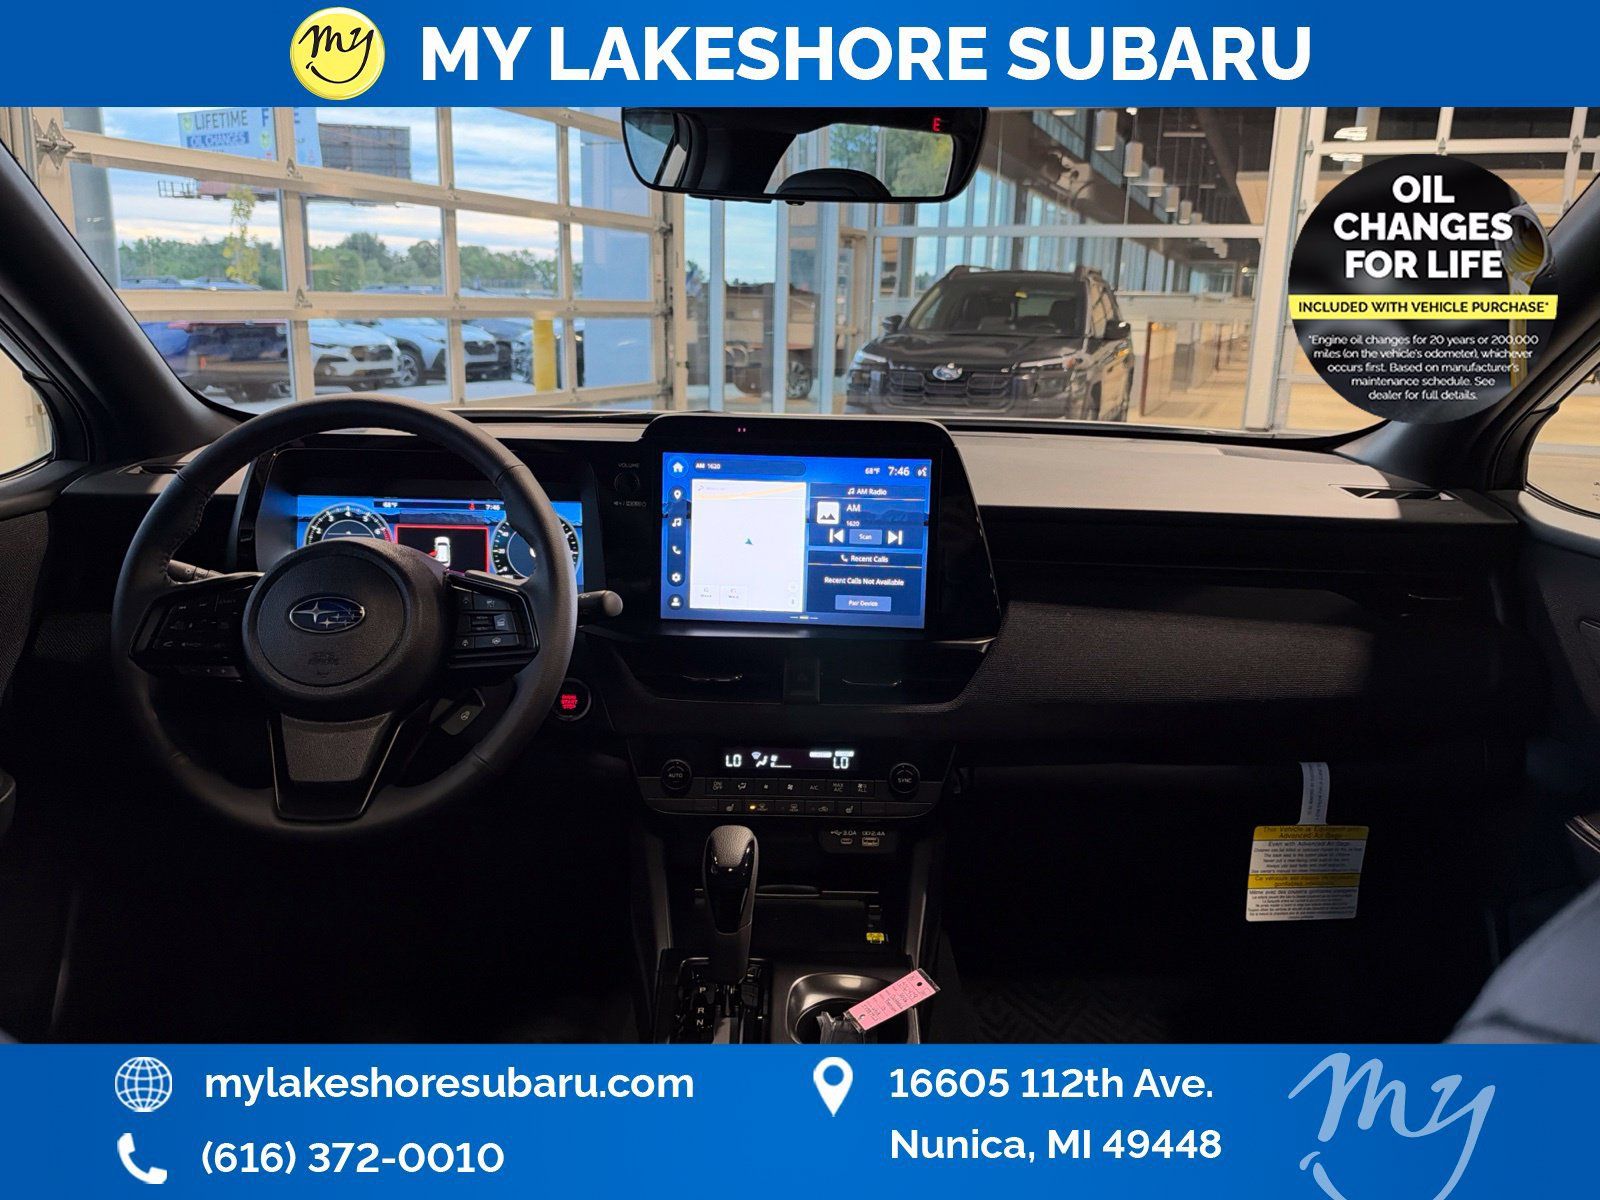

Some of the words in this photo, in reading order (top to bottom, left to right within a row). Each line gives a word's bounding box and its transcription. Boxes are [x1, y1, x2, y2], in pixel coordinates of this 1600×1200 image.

[194, 110, 248, 130] LIFETIME
[932, 117, 941, 132] E
[888, 466, 910, 477] 7:46
[869, 488, 888, 496] Radio
[846, 504, 861, 512] AM
[858, 533, 873, 541] Scan
[850, 555, 873, 563] Recent
[873, 555, 889, 563] Calls
[824, 576, 846, 584] Recent
[875, 578, 905, 586] Available
[897, 776, 913, 784] SYNC
[699, 986, 707, 994] P
[697, 1006, 705, 1014] R
